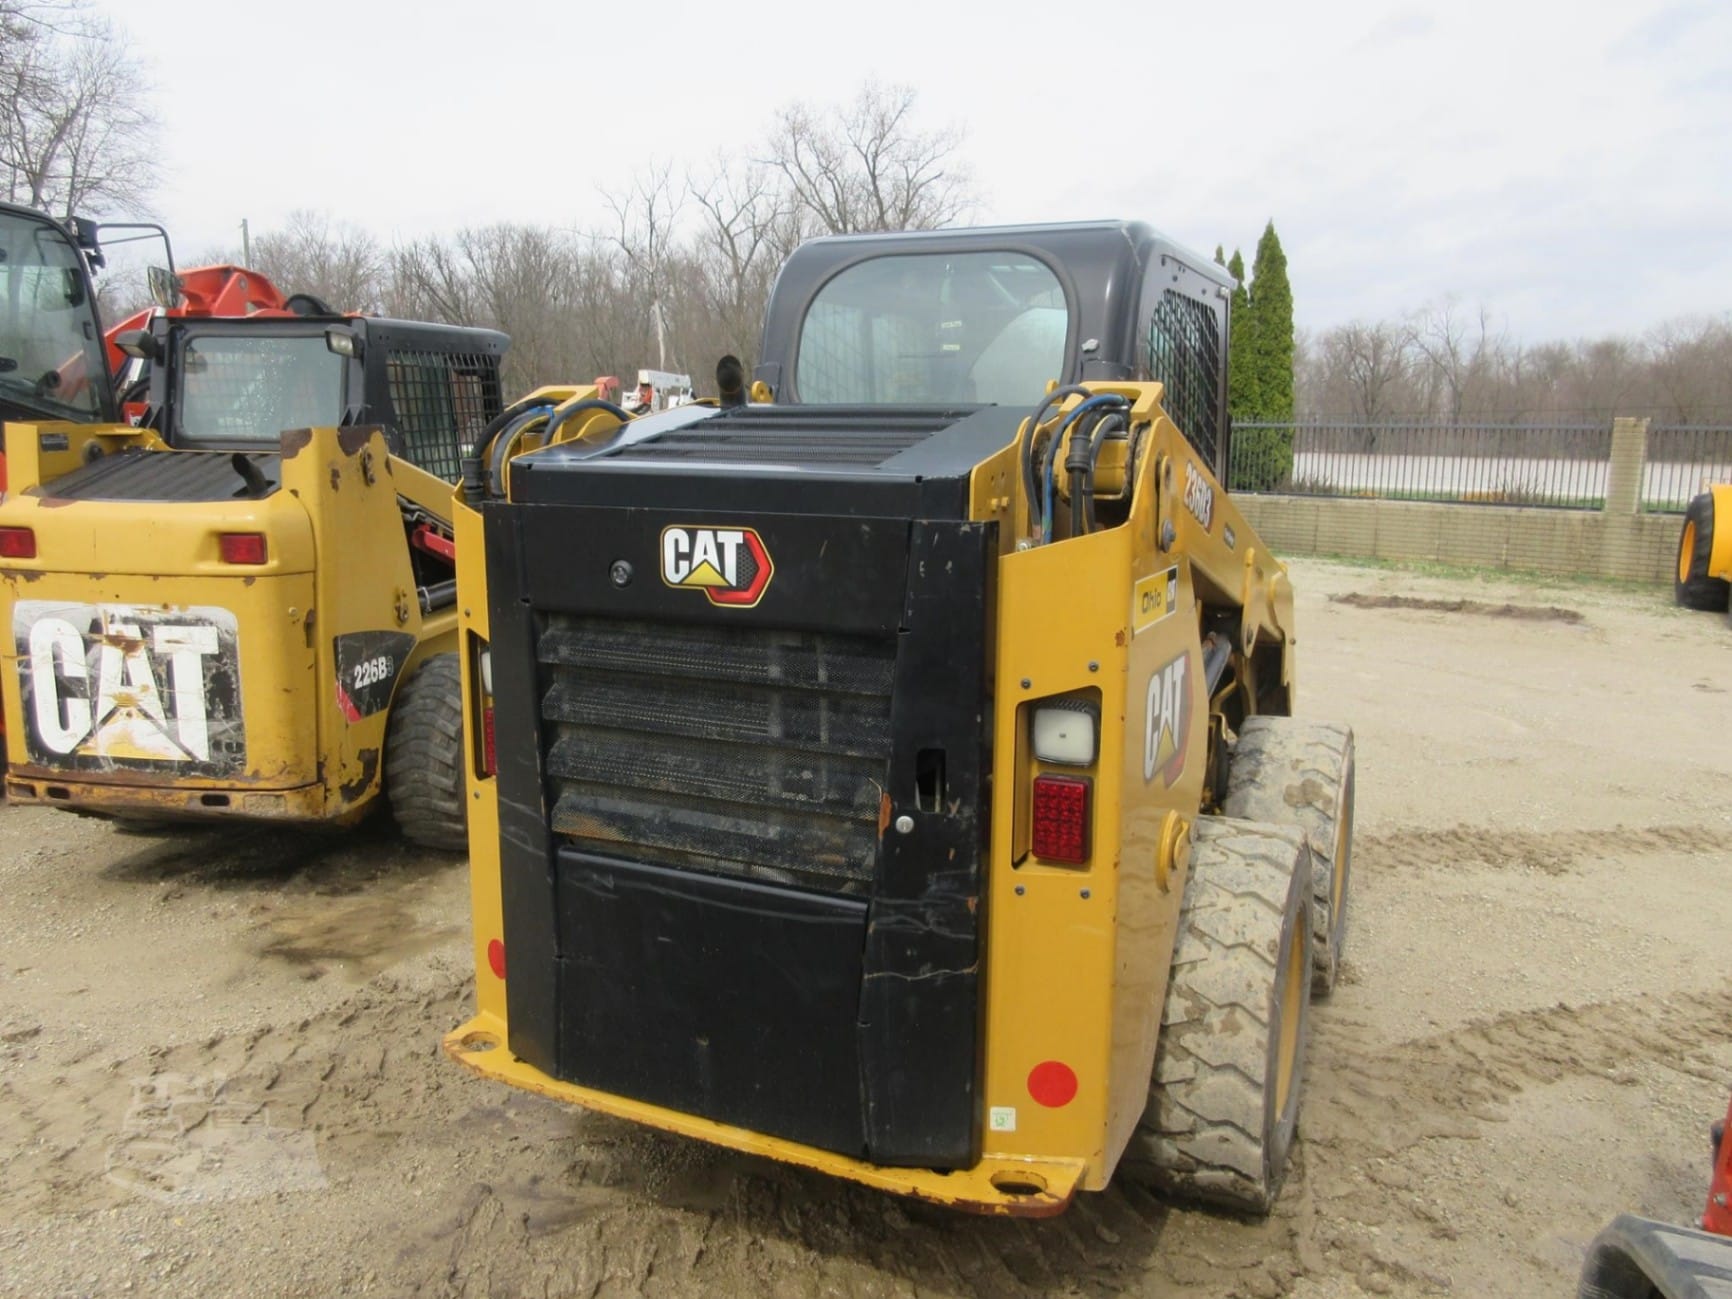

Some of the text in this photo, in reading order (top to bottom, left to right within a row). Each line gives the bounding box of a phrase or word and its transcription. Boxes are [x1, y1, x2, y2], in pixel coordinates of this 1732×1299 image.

[664, 528, 743, 587] CAT
[29, 617, 218, 762] CAT
[1144, 655, 1185, 779] CAT
